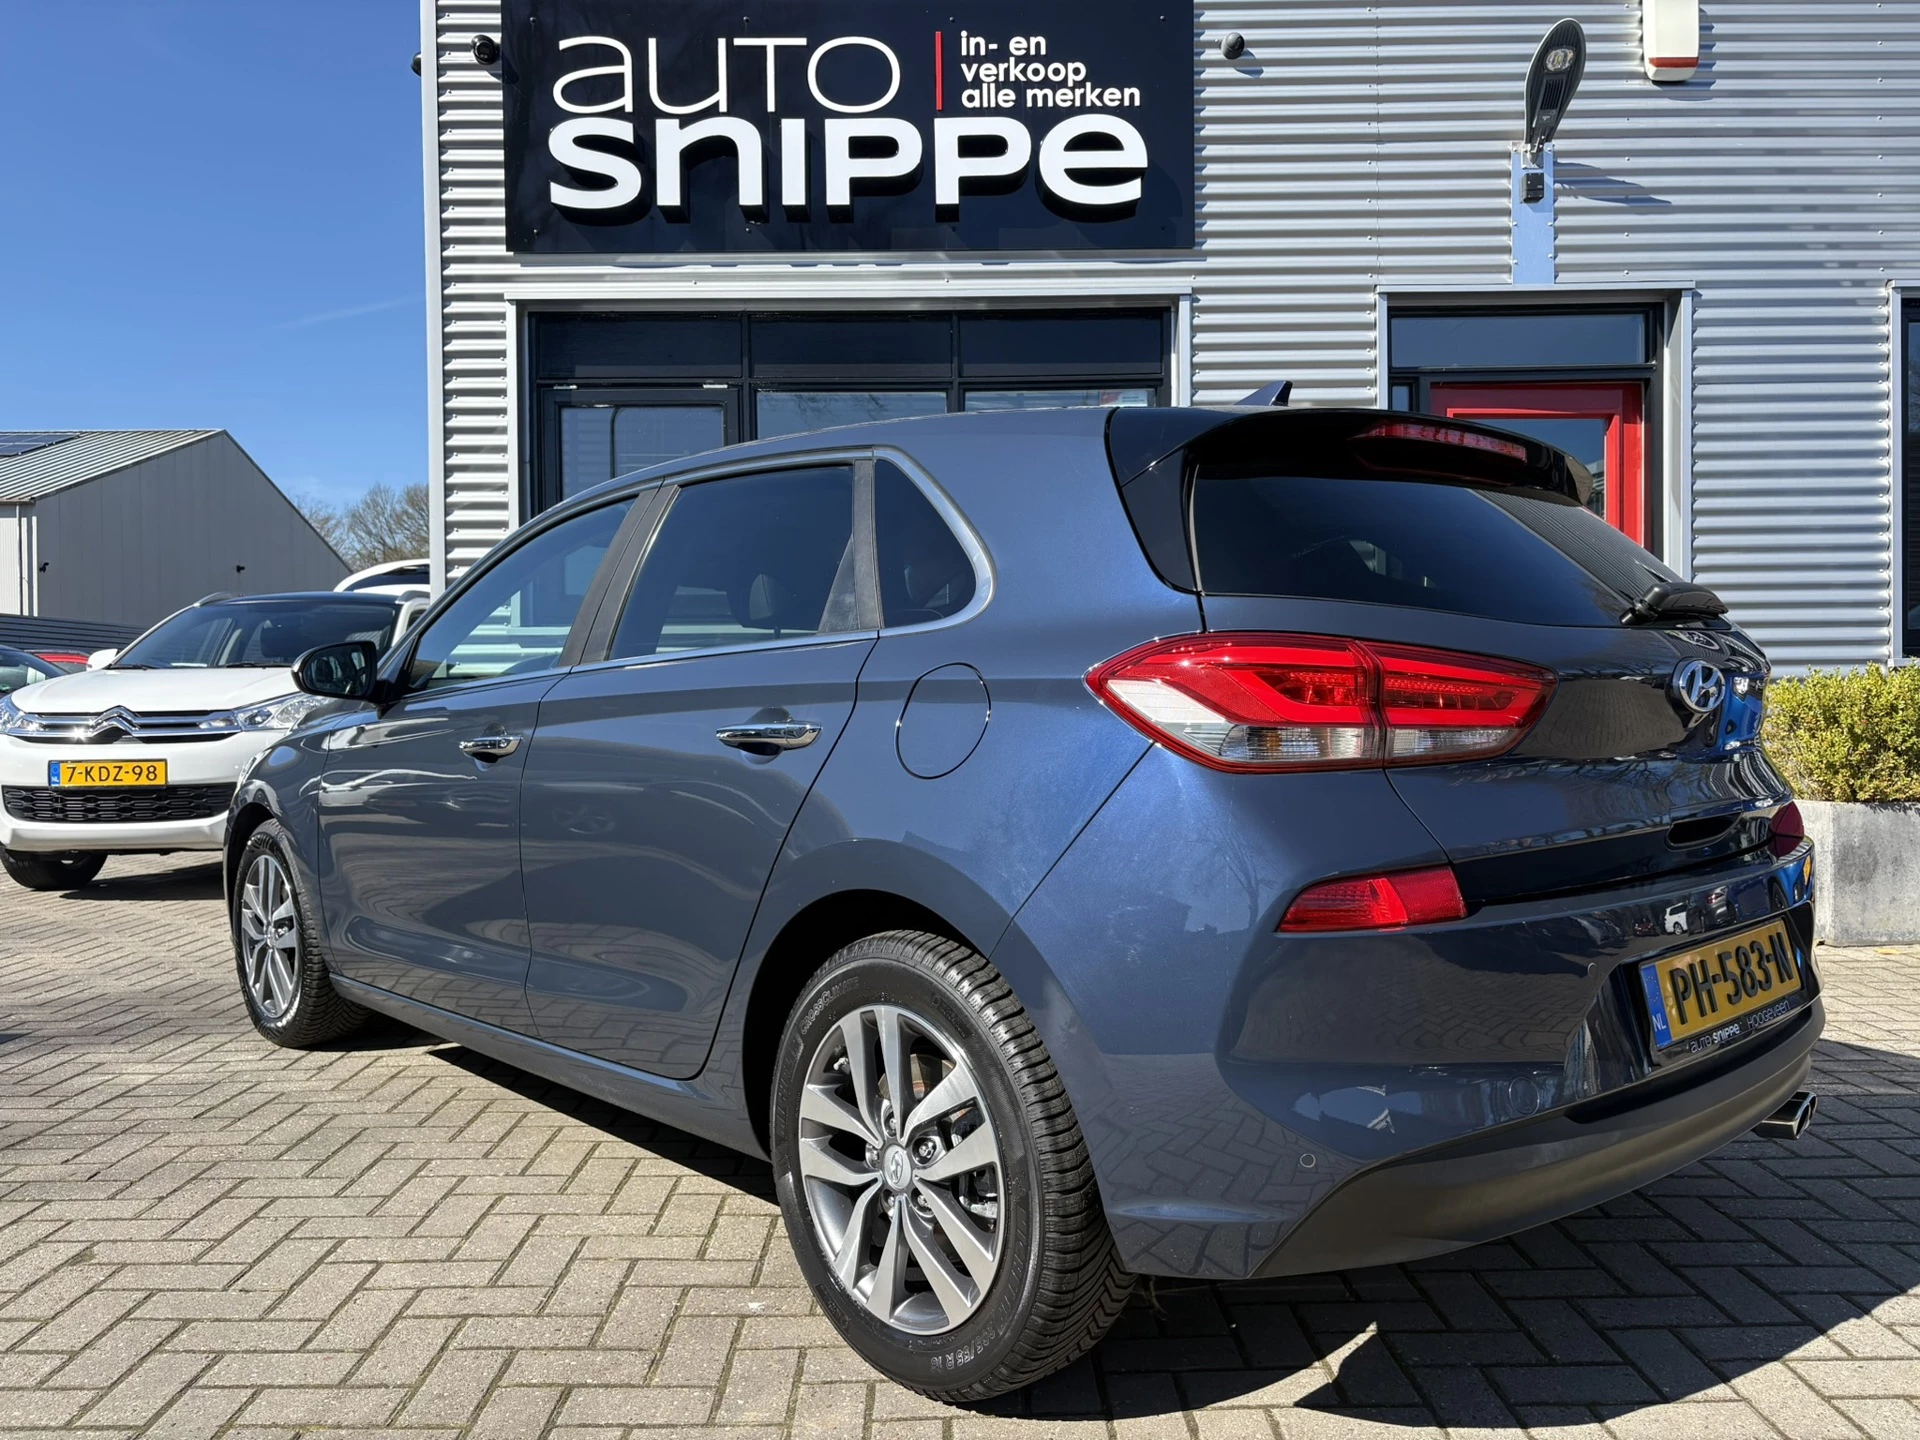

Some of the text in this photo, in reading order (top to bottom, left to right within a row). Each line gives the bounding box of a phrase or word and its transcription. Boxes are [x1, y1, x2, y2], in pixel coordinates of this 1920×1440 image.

[960, 30, 1046, 56] in- en
[960, 56, 1087, 87] verkoop
[961, 82, 1141, 108] alle merken
[66, 764, 158, 782] 7-KDZ-98
[1669, 931, 1795, 1025] PH-583-N
[1651, 1013, 1667, 1032] NL
